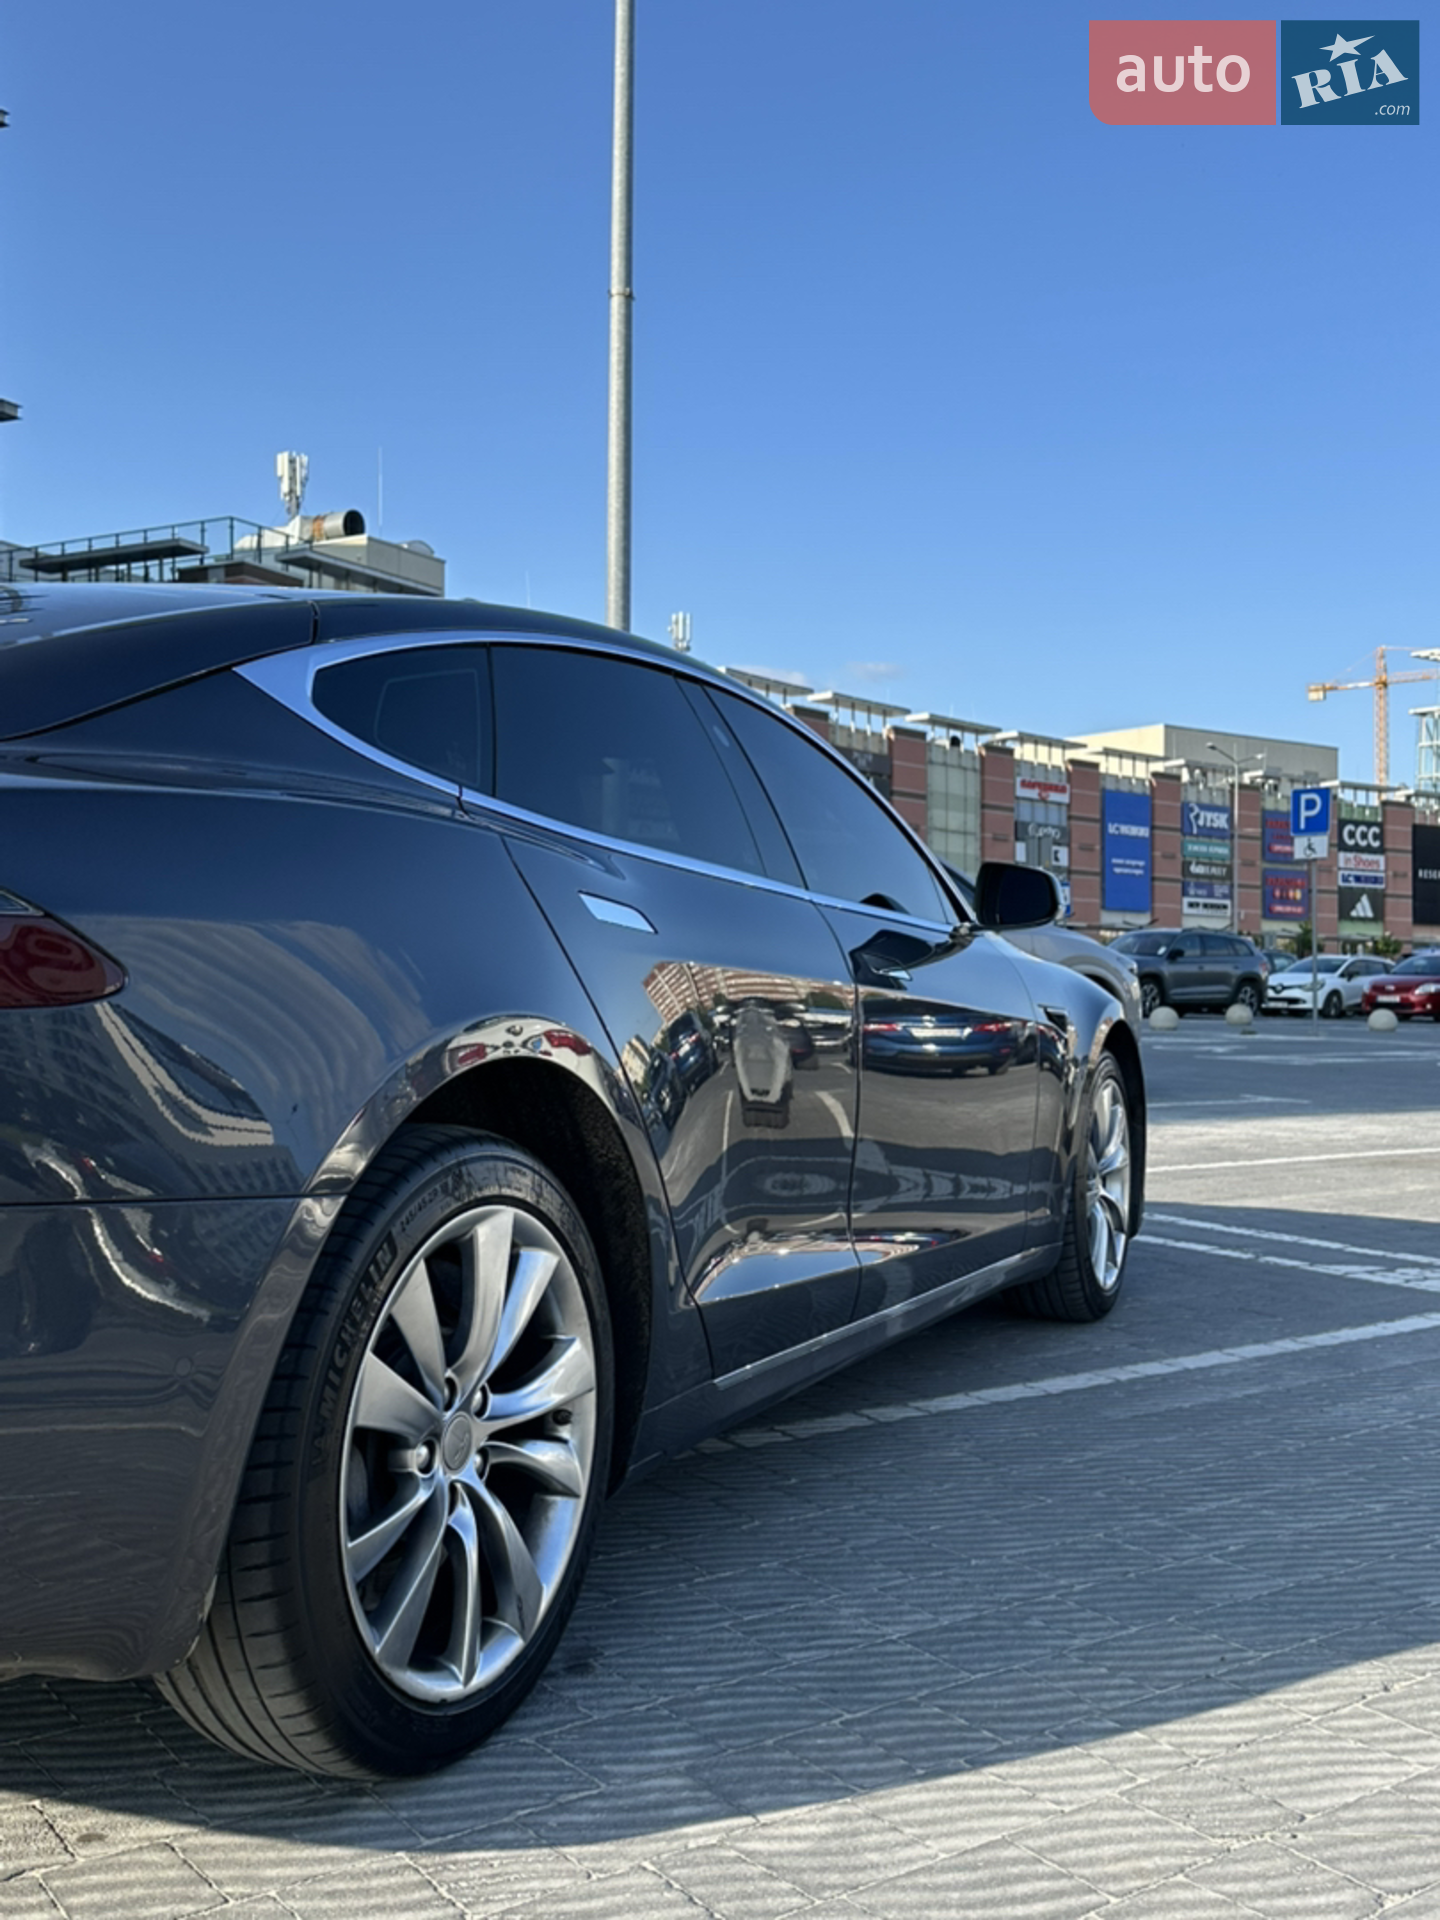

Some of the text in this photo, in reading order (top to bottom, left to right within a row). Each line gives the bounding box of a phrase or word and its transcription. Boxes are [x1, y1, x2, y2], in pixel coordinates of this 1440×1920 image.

[1198, 810, 1229, 830] JYSK
[1300, 792, 1323, 830] P
[1342, 823, 1381, 848] CCC
[319, 1241, 393, 1422] MICHELIN
